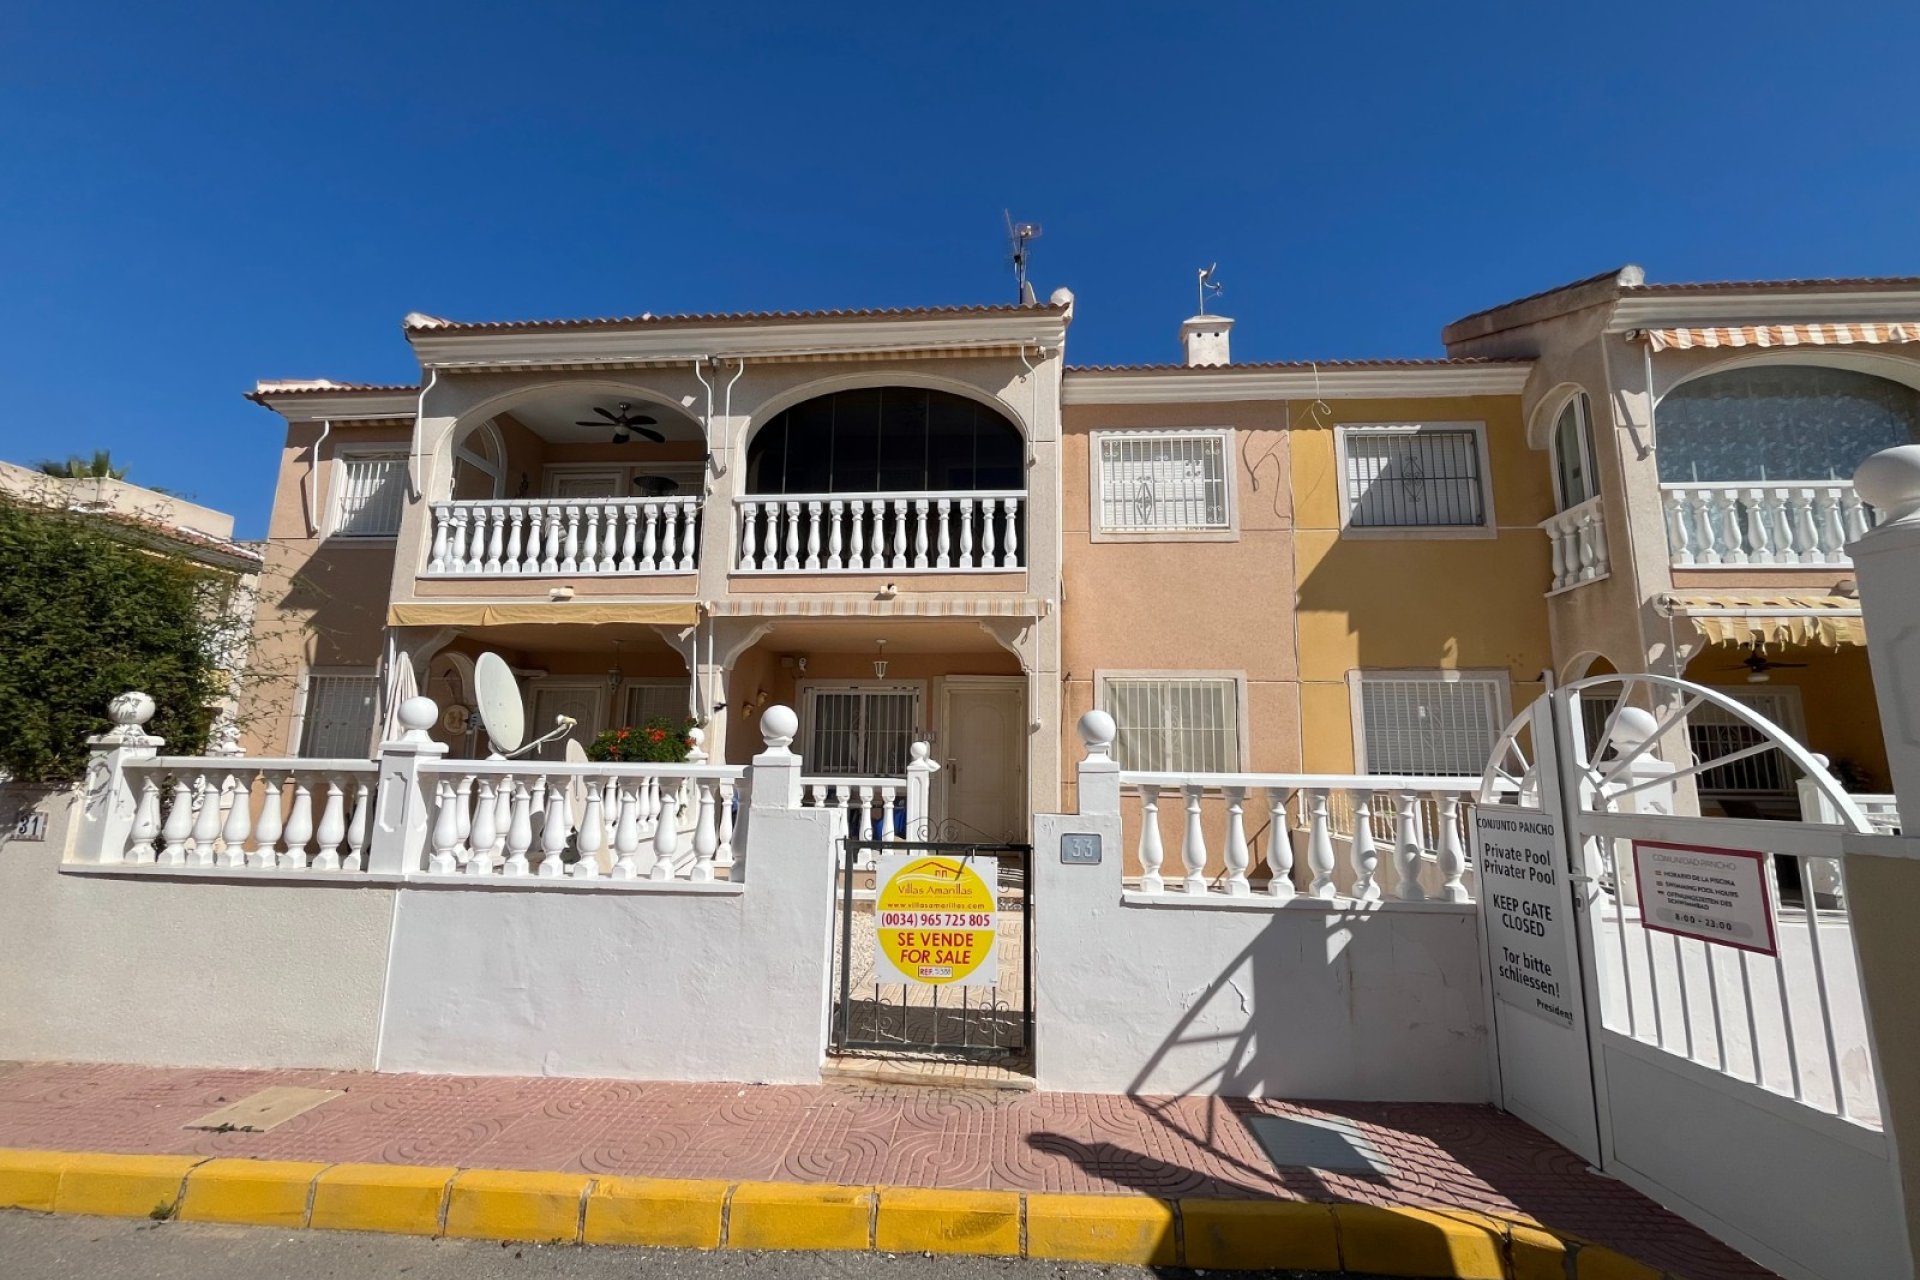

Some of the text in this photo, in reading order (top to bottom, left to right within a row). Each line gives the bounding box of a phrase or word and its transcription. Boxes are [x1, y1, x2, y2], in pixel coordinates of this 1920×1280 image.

[18, 815, 39, 836] 31
[1476, 818, 1554, 836] CONJUNTO PANCHO
[1072, 838, 1093, 857] 33
[1484, 842, 1551, 866] Private Pool
[1484, 858, 1555, 885] Privater Pool
[1664, 871, 1691, 880] HORARIO
[1709, 877, 1736, 886] PISCINA
[898, 883, 973, 895] Villas Amarillas
[887, 902, 985, 910] www.villasamarillas.com
[1493, 893, 1552, 921] KEEP GATE
[881, 912, 990, 928] (0034) 965 725 805
[1502, 913, 1545, 937] CLOSED
[898, 932, 974, 947] SE VENDE
[900, 949, 971, 964] FOR SALE
[1502, 946, 1552, 977] Tor bitte
[1499, 964, 1560, 998] schliessen!
[1536, 998, 1574, 1021] President
